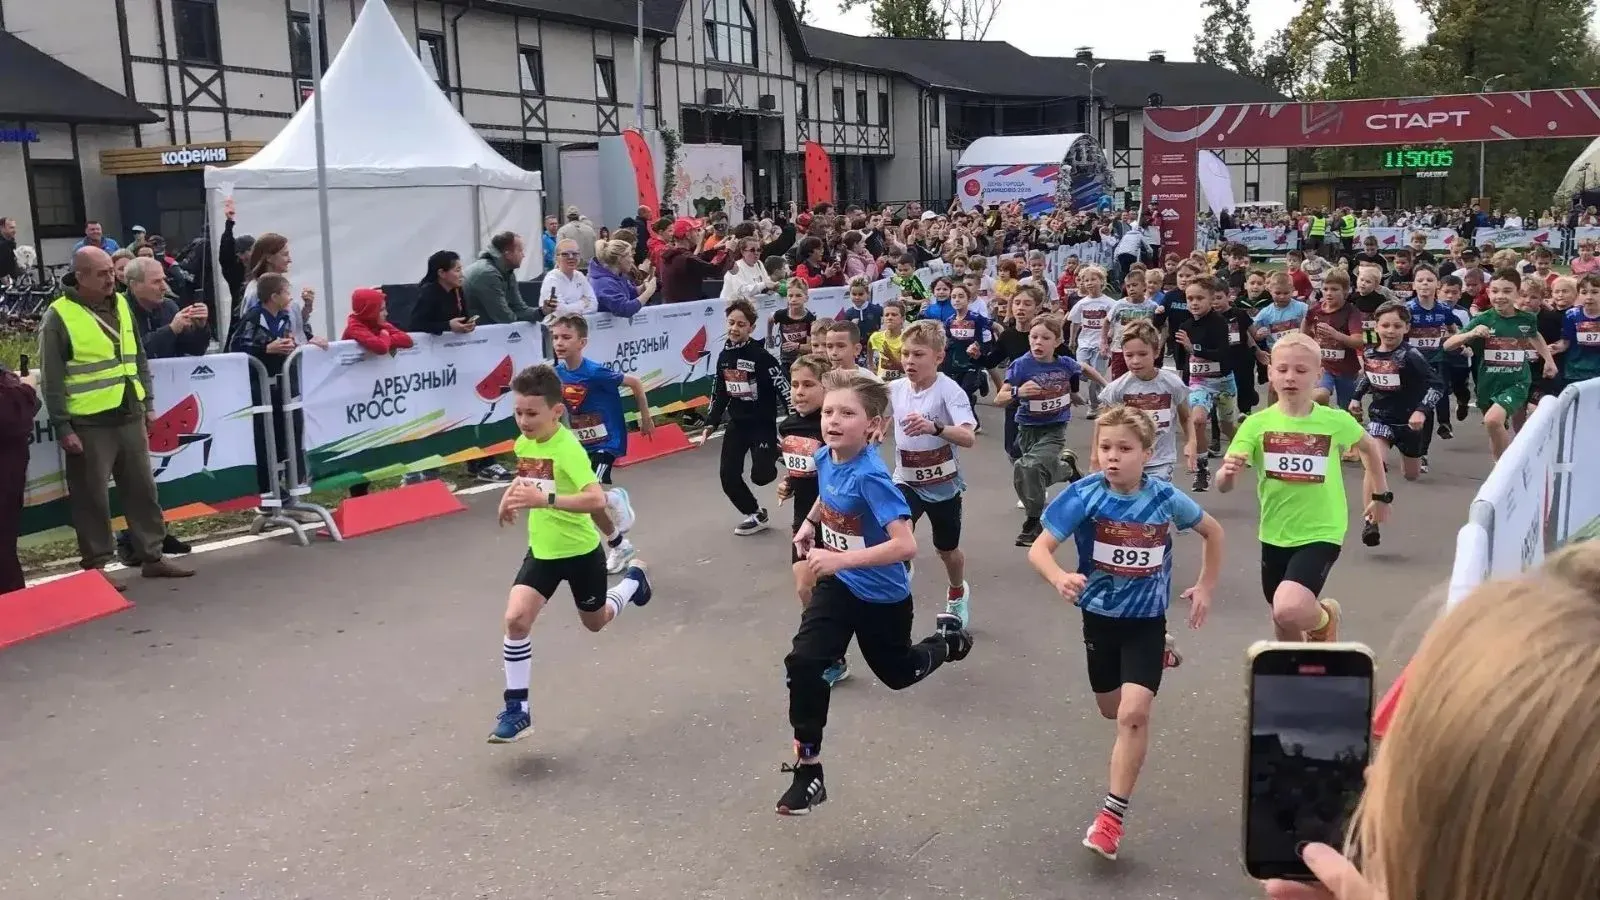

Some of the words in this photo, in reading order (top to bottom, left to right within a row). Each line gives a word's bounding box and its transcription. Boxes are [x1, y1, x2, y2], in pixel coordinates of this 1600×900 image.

[1365, 110, 1471, 130] СТАРТ
[160, 146, 228, 168] кофейня
[615, 331, 669, 358] АРБУЗНЫЙ
[1418, 339, 1437, 347] 817
[1494, 351, 1516, 361] 821
[604, 356, 638, 374] РОСС
[1192, 364, 1210, 373] 873
[372, 363, 457, 399] АРБУЗНЫЙ
[1371, 374, 1389, 385] 815
[346, 395, 407, 424] КРОСС
[1040, 399, 1062, 411] 825
[577, 428, 597, 440] 820
[788, 456, 807, 470] 883
[1278, 456, 1314, 473] 850
[915, 466, 944, 481] 834
[825, 528, 849, 551] 813
[1111, 548, 1151, 567] 893
